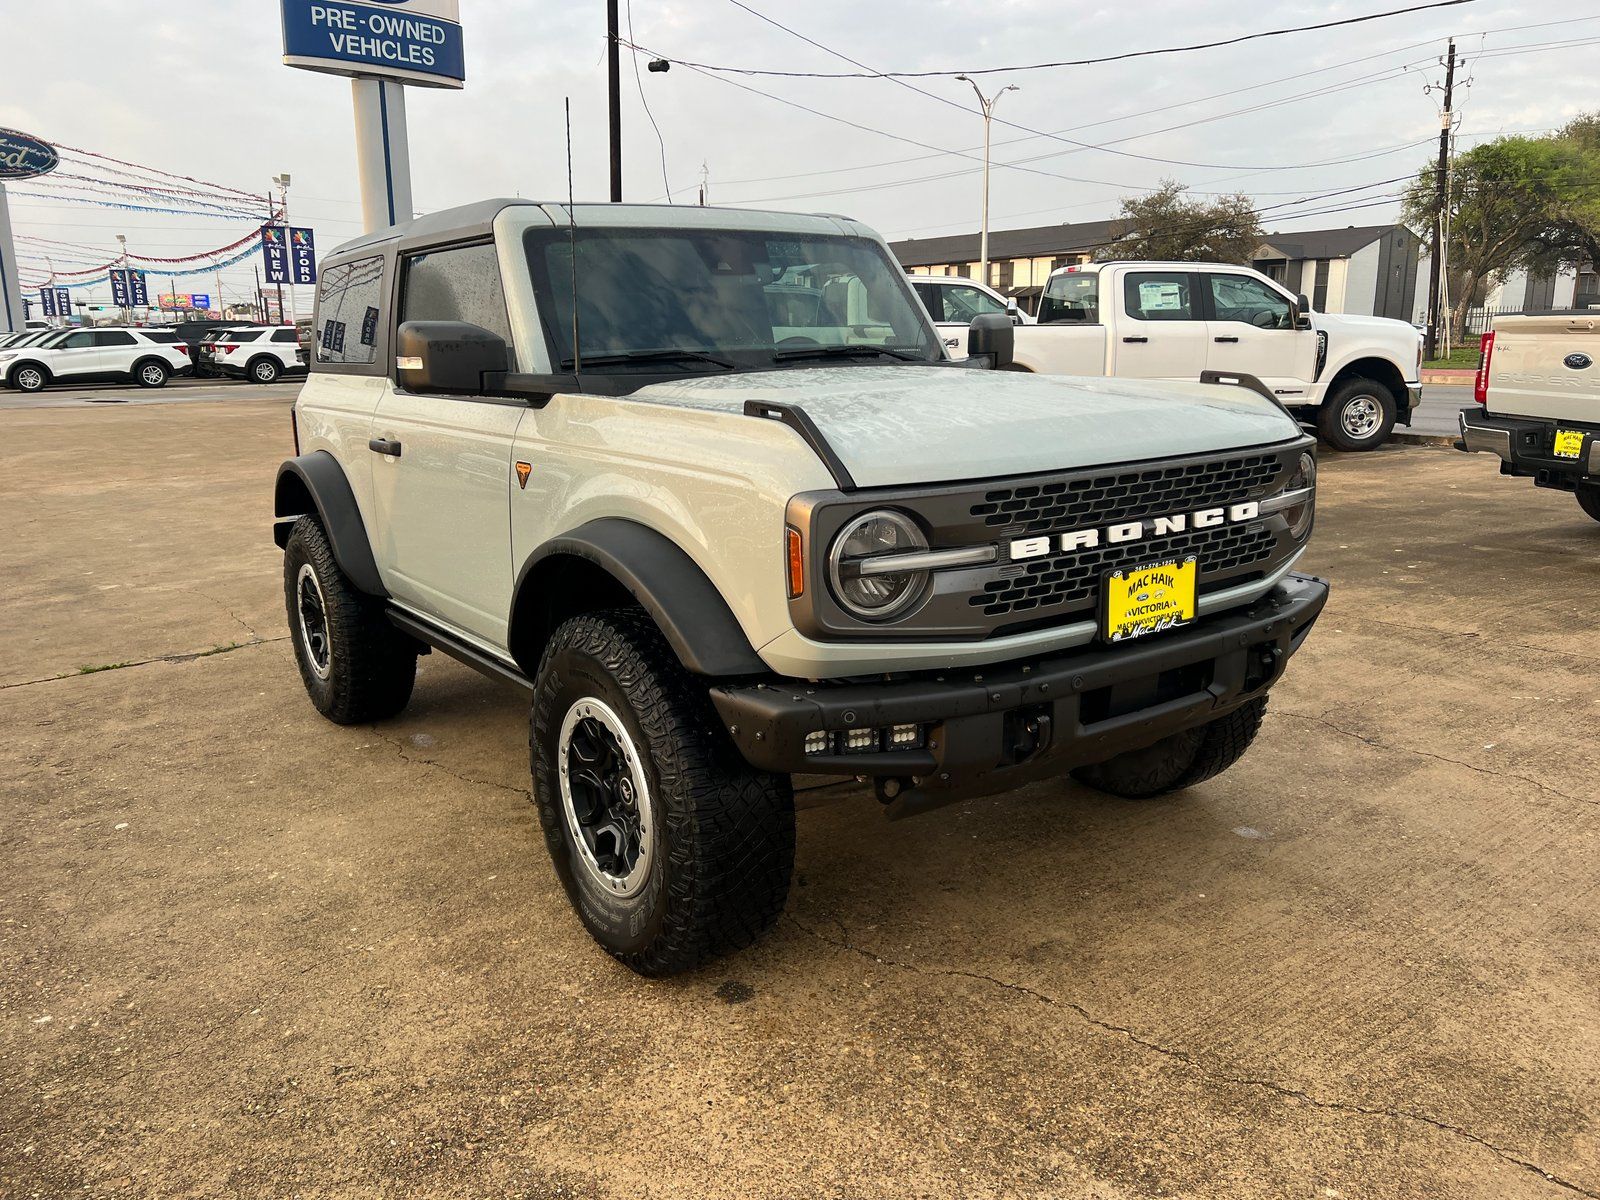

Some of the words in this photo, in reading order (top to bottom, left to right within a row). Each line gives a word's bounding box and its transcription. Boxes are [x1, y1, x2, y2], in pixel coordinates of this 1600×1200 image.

[329, 32, 435, 66] VEHICLES
[270, 248, 284, 281] NEW
[299, 250, 311, 282] FORD
[59, 293, 69, 315] OWNED
[115, 283, 126, 304] NEW
[134, 283, 144, 304] FORD
[1497, 372, 1583, 388] SUPER
[1009, 501, 1260, 561] BRONCO
[1127, 575, 1149, 598] MAC
[1151, 573, 1175, 589] HAIK
[1131, 600, 1171, 617] VICTORIA
[1131, 623, 1153, 639] Mac
[1154, 616, 1183, 633] Haik
